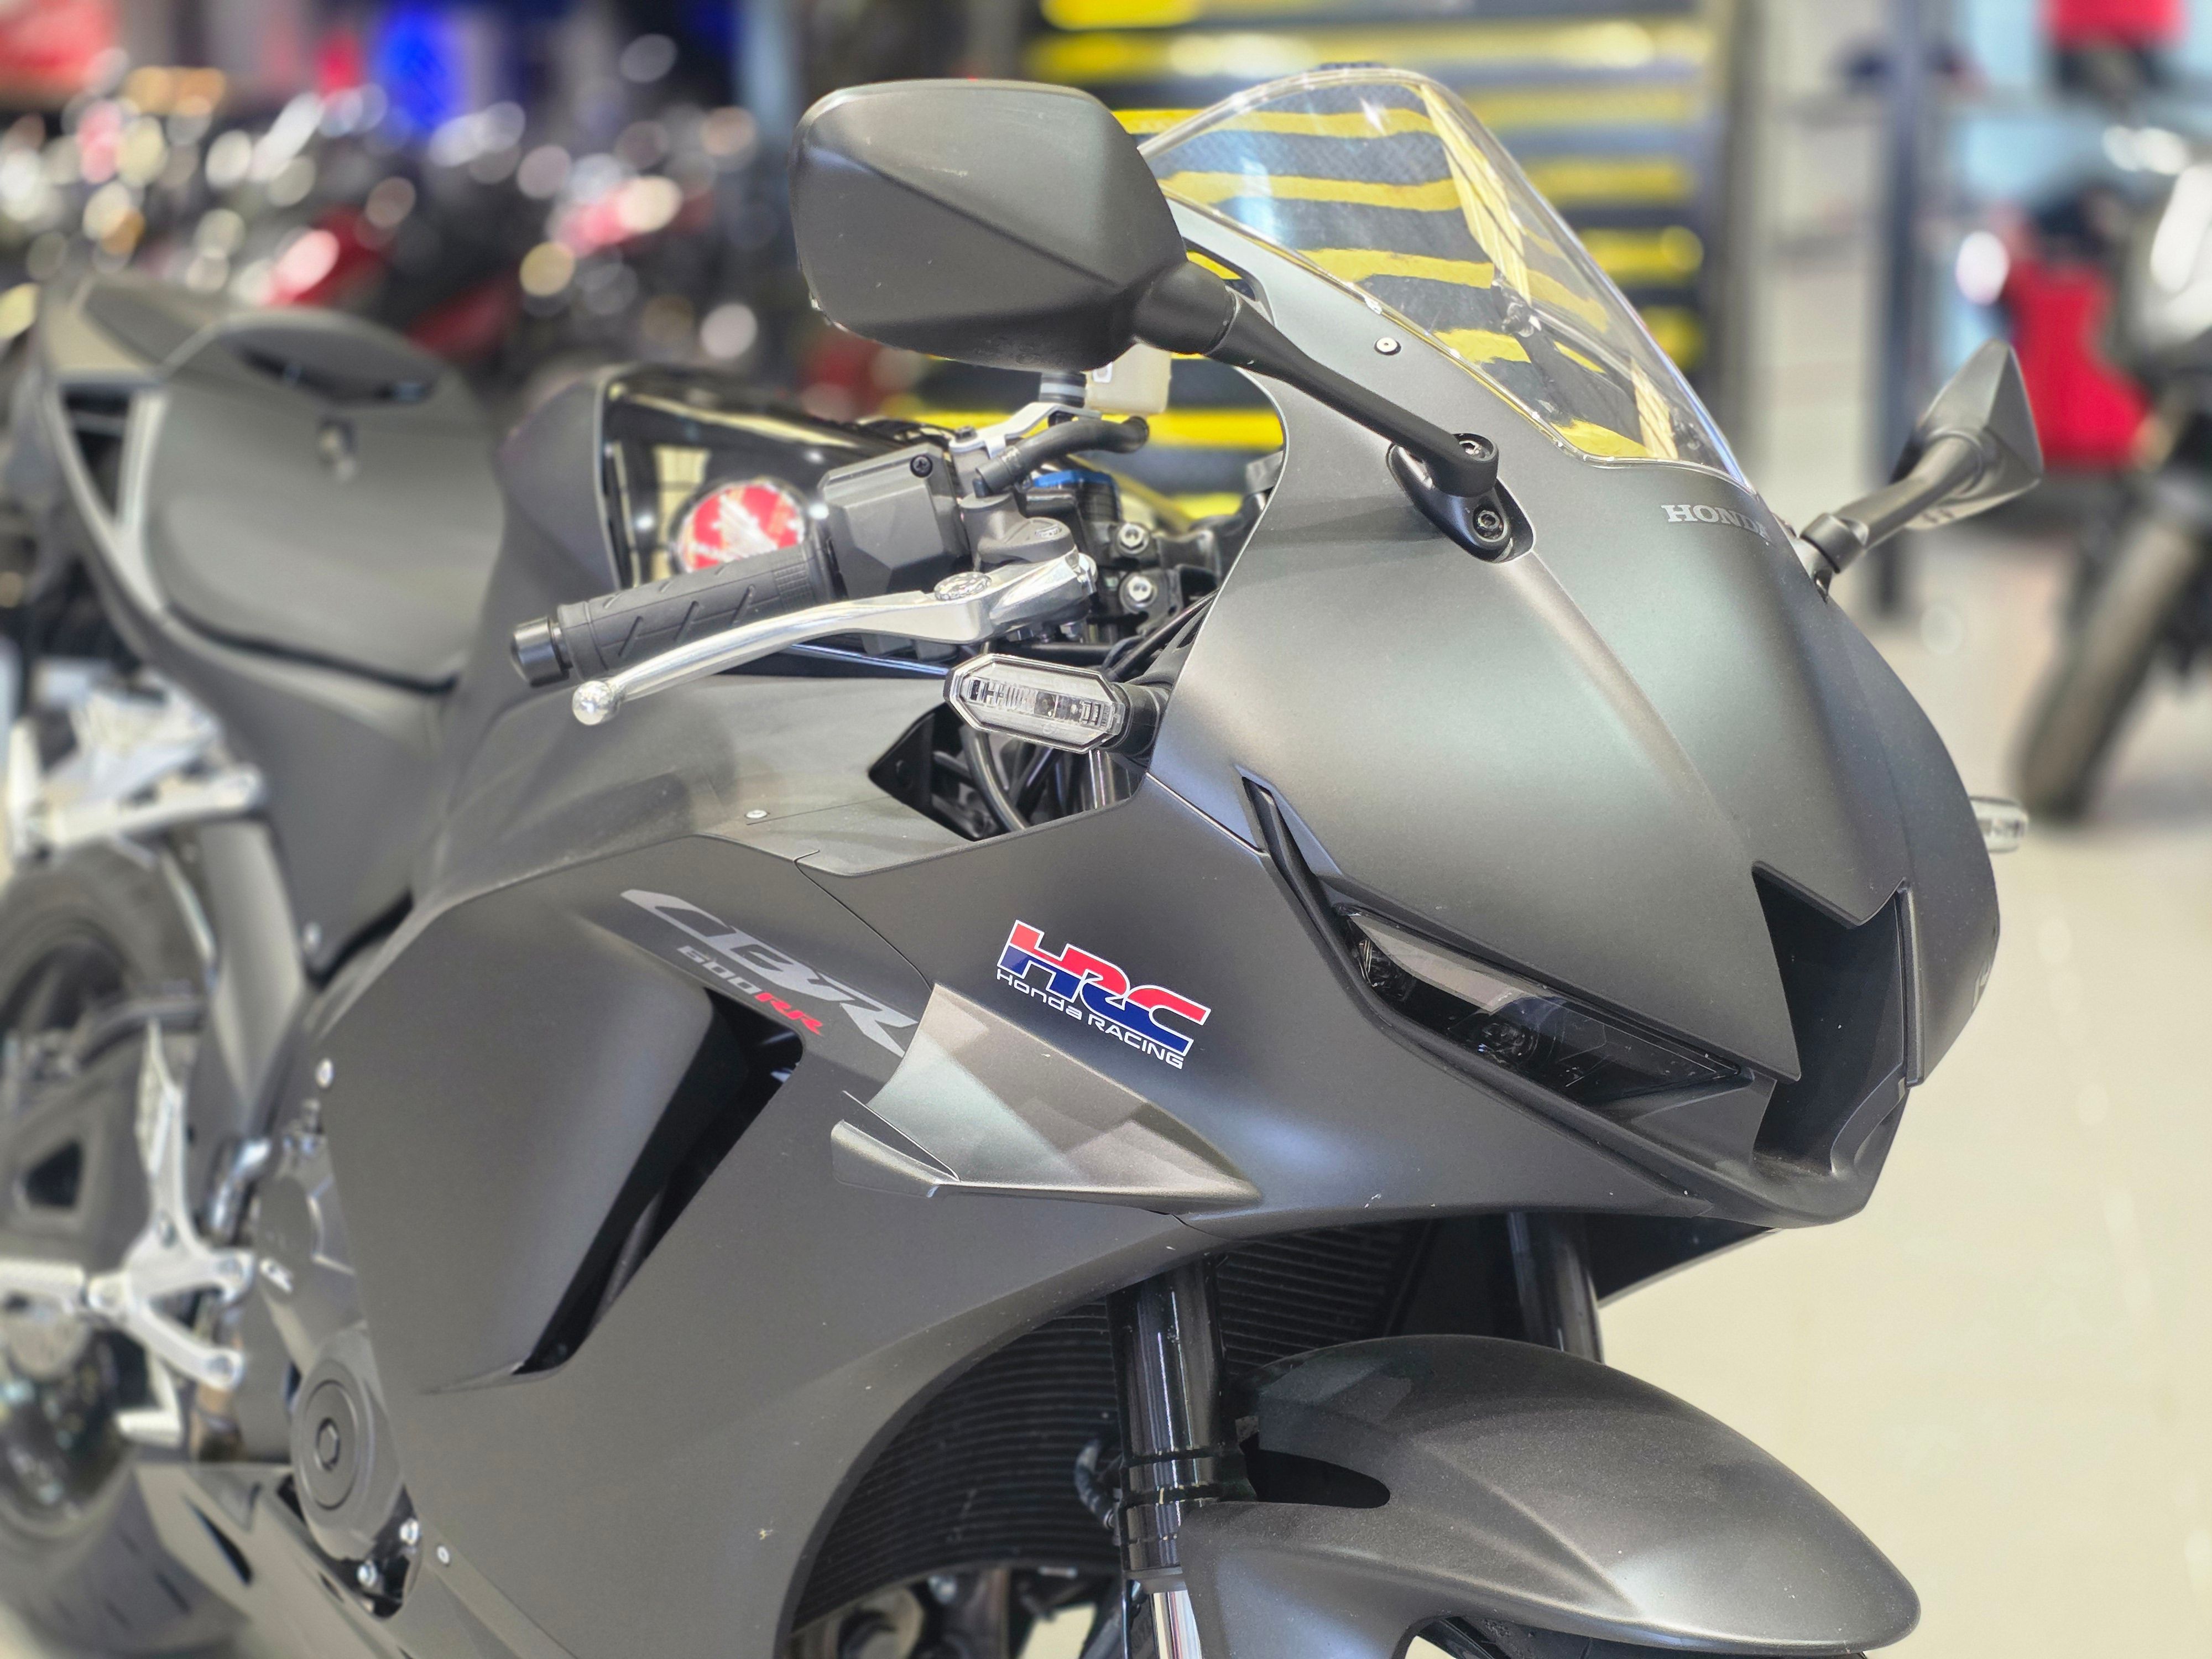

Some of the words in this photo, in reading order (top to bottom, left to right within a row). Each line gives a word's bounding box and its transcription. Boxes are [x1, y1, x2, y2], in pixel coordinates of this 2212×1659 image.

[1661, 504, 1771, 541] HONDA
[620, 889, 920, 1058] CBR
[676, 945, 823, 1036] 600RR
[997, 919, 1212, 1057] HRC
[997, 968, 1082, 1020] Honda
[1087, 1013, 1185, 1070] RACING
